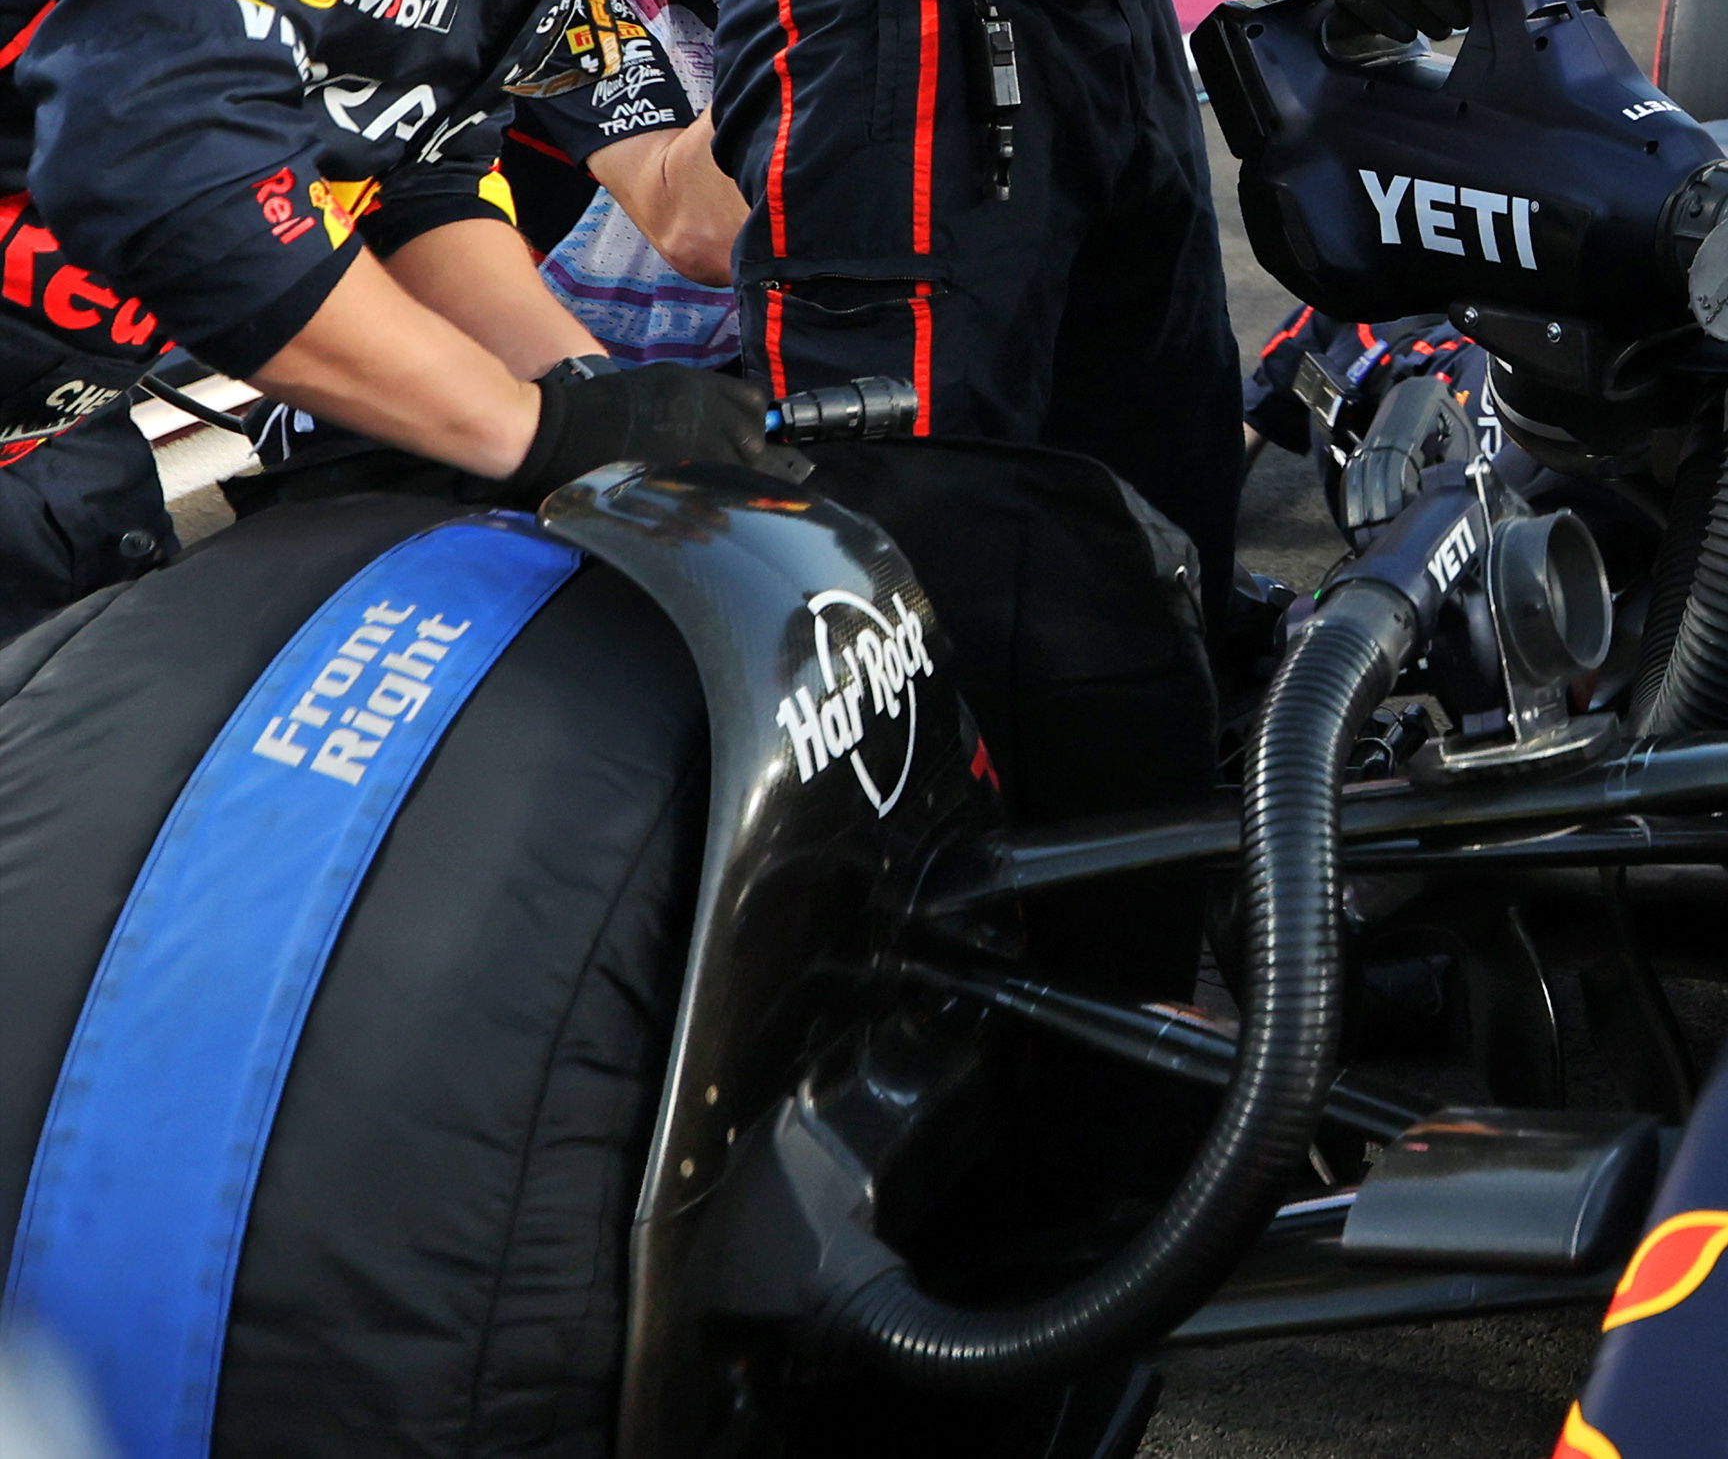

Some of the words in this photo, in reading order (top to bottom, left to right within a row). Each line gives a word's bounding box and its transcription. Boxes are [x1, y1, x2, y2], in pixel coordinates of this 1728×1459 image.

[599, 112, 676, 136] TRADE
[612, 103, 656, 120] AVA
[1357, 169, 1538, 271] YETI
[1427, 517, 1478, 595] YETI
[252, 598, 418, 769] Front
[310, 612, 473, 788] Right
[857, 591, 933, 720] Rock
